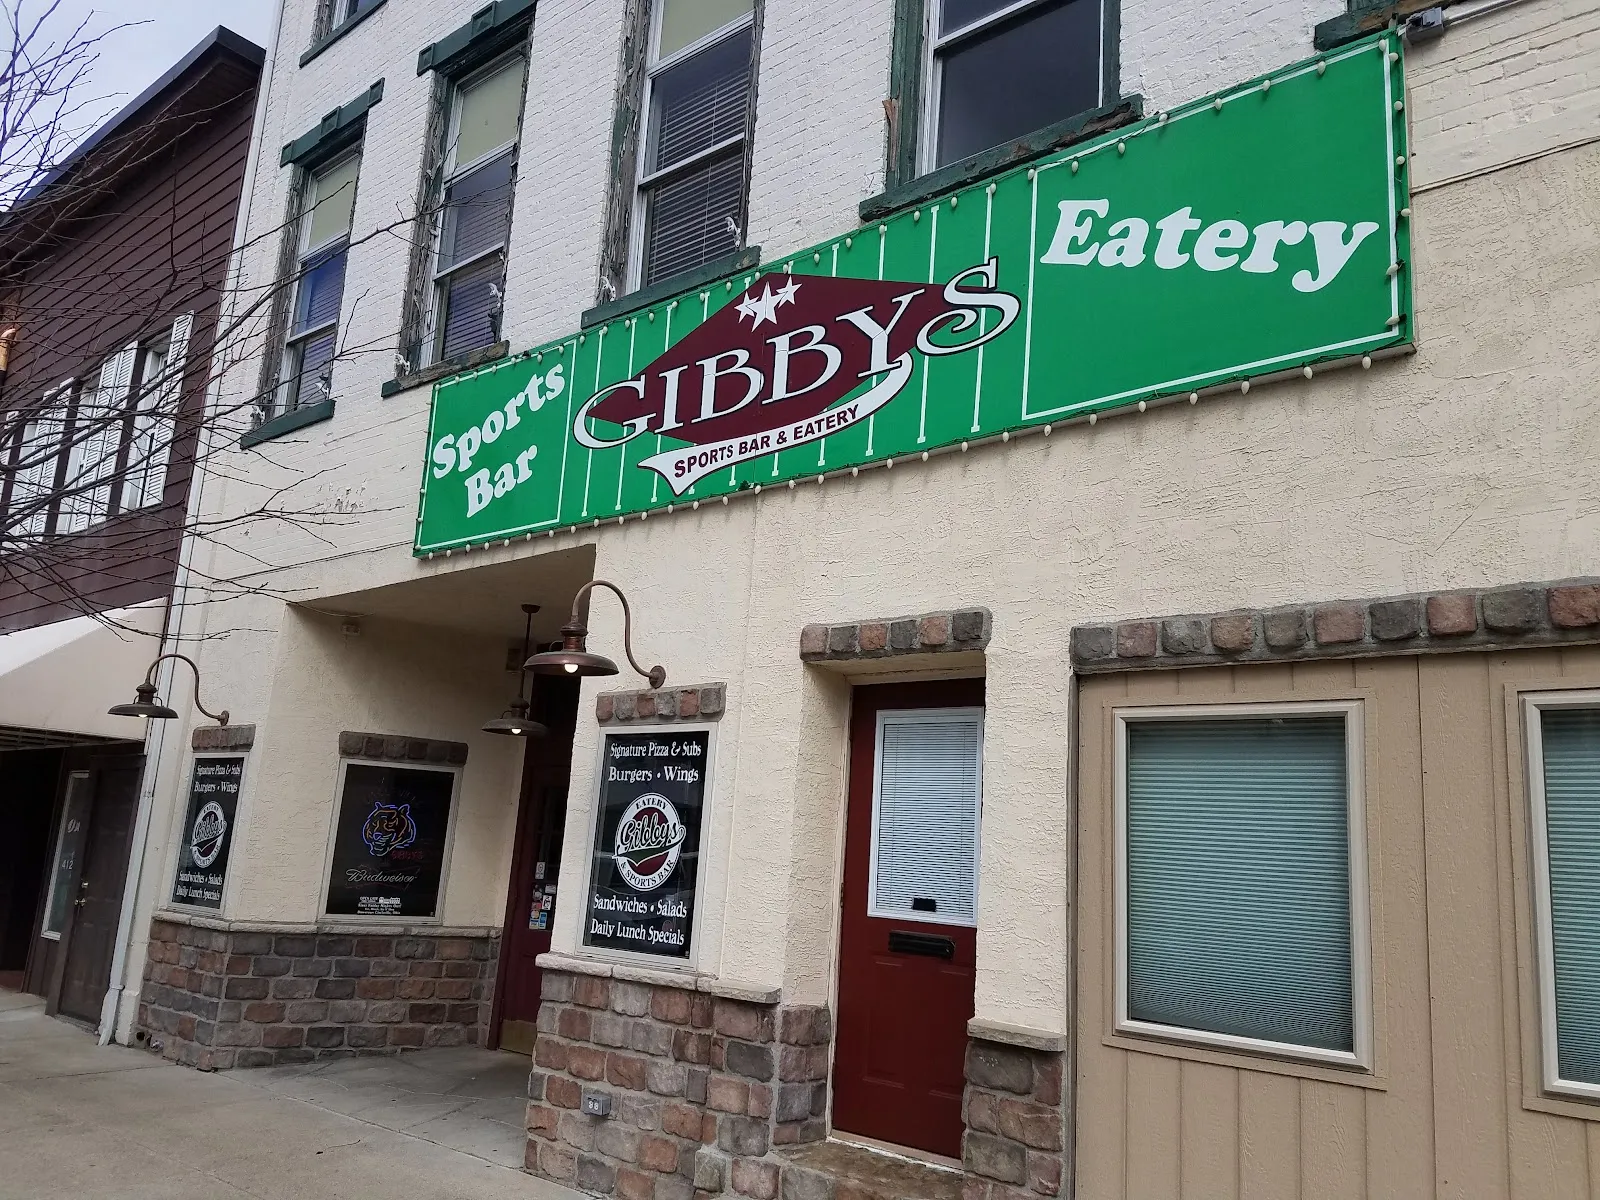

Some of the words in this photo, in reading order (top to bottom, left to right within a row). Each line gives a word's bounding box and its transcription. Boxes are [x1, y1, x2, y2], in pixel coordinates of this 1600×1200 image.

[1040, 198, 1380, 293] Eatery
[572, 256, 1021, 450] GIBBYS
[432, 360, 566, 480] Sports
[673, 443, 734, 479] SPORTS
[738, 435, 772, 457] BAR
[775, 431, 788, 446] &
[792, 403, 860, 442] EATERY
[464, 443, 538, 518] Bar
[610, 742, 647, 758] Signature
[648, 742, 669, 757] Pizza
[671, 741, 681, 756] &
[682, 741, 701, 756] Subs
[225, 763, 232, 775] &
[608, 766, 653, 783] Burgers
[664, 766, 699, 783] Wings
[194, 781, 216, 794] Burgers
[221, 781, 238, 794] Wings
[635, 797, 669, 810] EATERY
[620, 811, 677, 851] Gibbys
[62, 860, 73, 870] 412
[346, 868, 417, 883] Budweiser
[621, 861, 628, 870] &
[625, 869, 657, 887] SPORTS
[658, 859, 675, 880] BAR
[179, 870, 205, 883] Sandwiches
[208, 873, 223, 886] Salads
[593, 893, 648, 914] Sandwiches
[657, 899, 687, 918] Salads
[590, 918, 615, 937] Daily
[616, 921, 646, 941] Lunch
[647, 925, 685, 945] Specials
